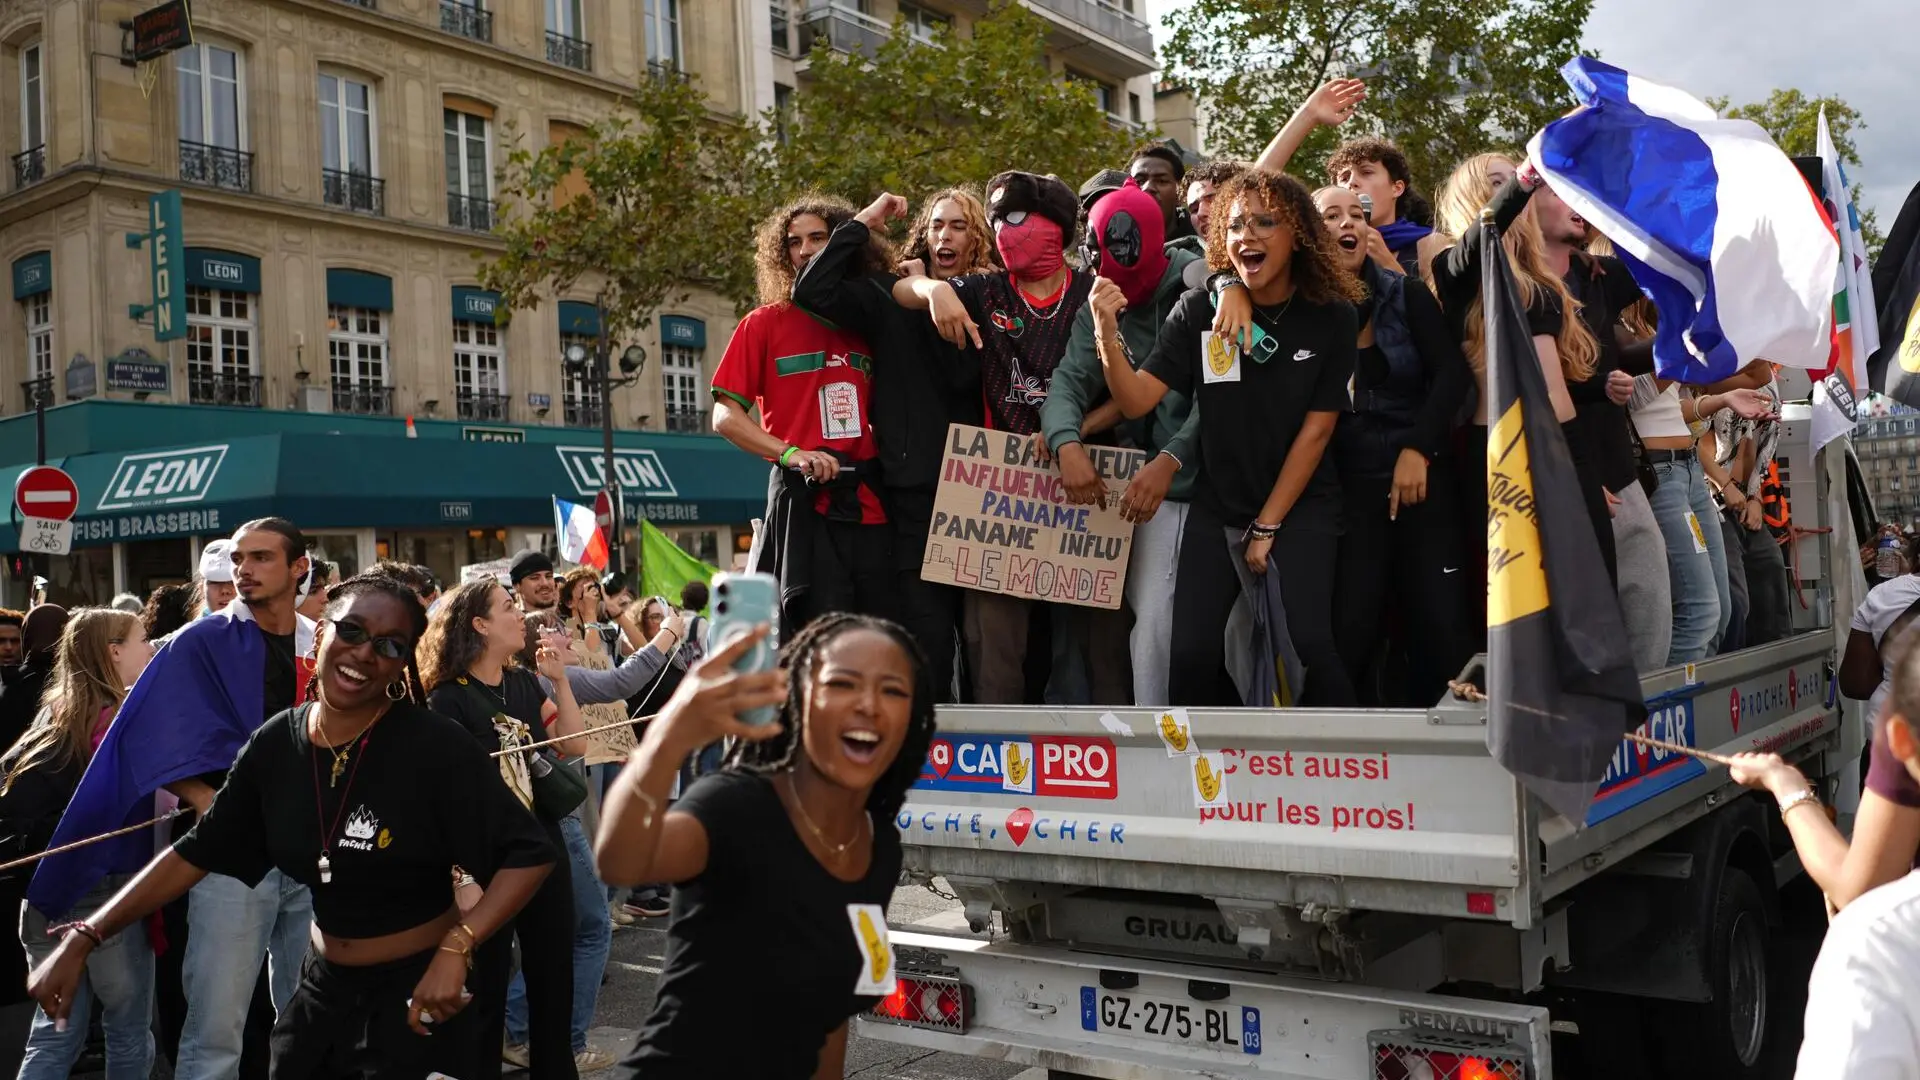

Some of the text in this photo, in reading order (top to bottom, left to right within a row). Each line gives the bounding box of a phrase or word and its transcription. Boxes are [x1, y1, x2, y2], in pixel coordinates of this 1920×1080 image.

[207, 263, 239, 279] LEON
[469, 299, 492, 313] LEON
[108, 379, 165, 388] MONTPARNASSE
[114, 363, 160, 373] BOULEVARD
[951, 427, 989, 459] LA
[944, 458, 1076, 506] INFLUENC
[36, 519, 63, 529] SAUF
[73, 508, 220, 541] FISH BRASSERIE
[443, 505, 469, 518] LEON
[625, 503, 699, 520] RASSERIE
[931, 511, 1039, 550] PANAME
[954, 546, 1117, 604] LE MONDE
[1651, 704, 1688, 761] CAR
[957, 742, 1003, 775] CA
[1042, 743, 1109, 778] PRO
[1220, 748, 1389, 780] C'est aussi
[1199, 796, 1414, 832] pour les pros!
[1034, 818, 1125, 844] CHER
[1125, 915, 1238, 945] GRUAU
[1085, 1010, 1092, 1020] F
[1101, 996, 1239, 1045] GZ-275-BL
[1399, 1008, 1520, 1040] RENAULT
[1244, 1032, 1260, 1048] 03
